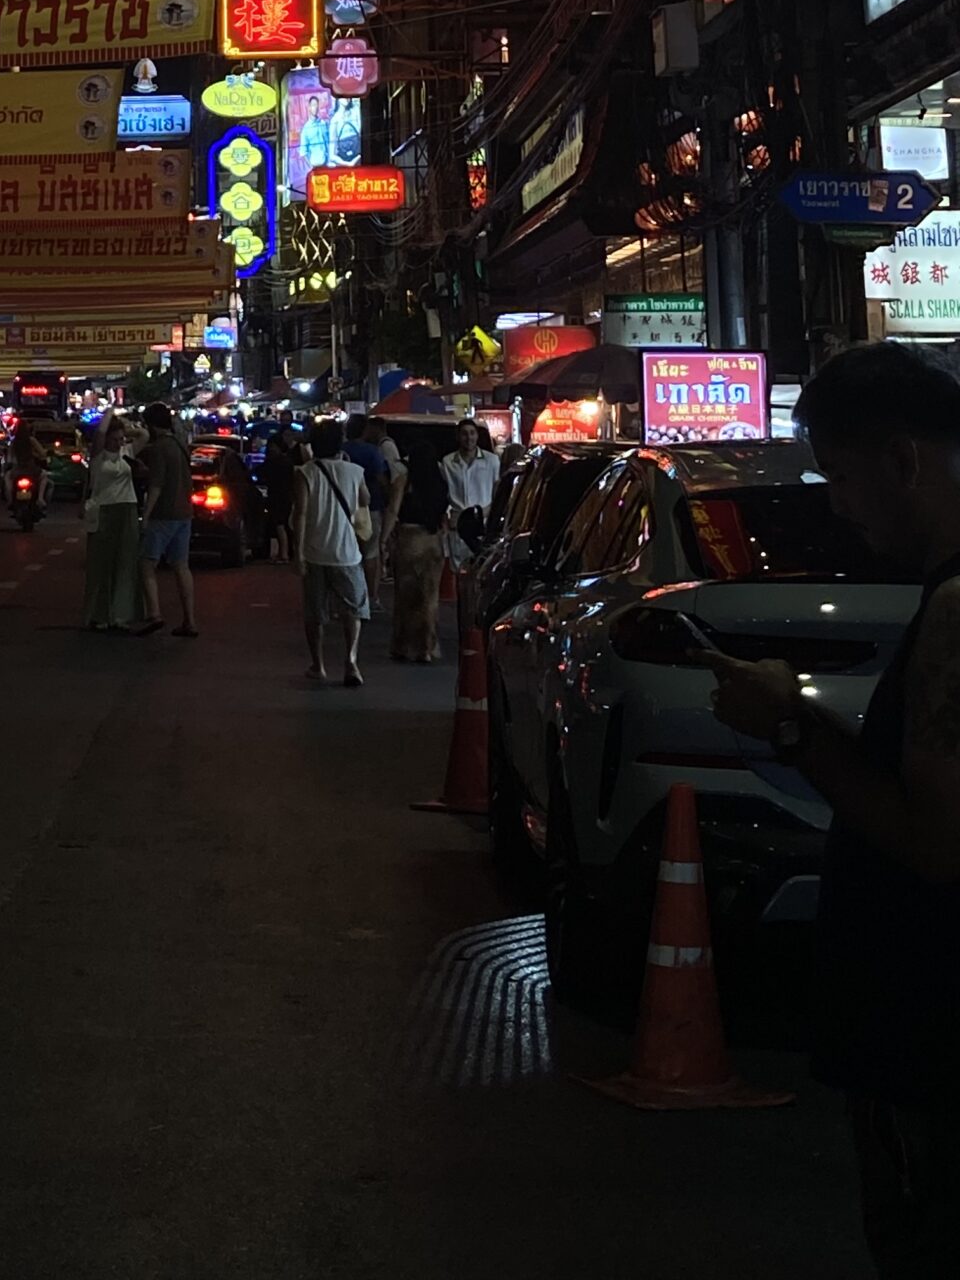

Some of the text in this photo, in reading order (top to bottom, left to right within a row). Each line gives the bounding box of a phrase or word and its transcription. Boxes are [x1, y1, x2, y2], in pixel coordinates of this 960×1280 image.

[213, 90, 264, 106] NaRaYa
[896, 183, 915, 210] 2
[889, 299, 925, 319] SCALA
[655, 374, 751, 404] เกาลัด
